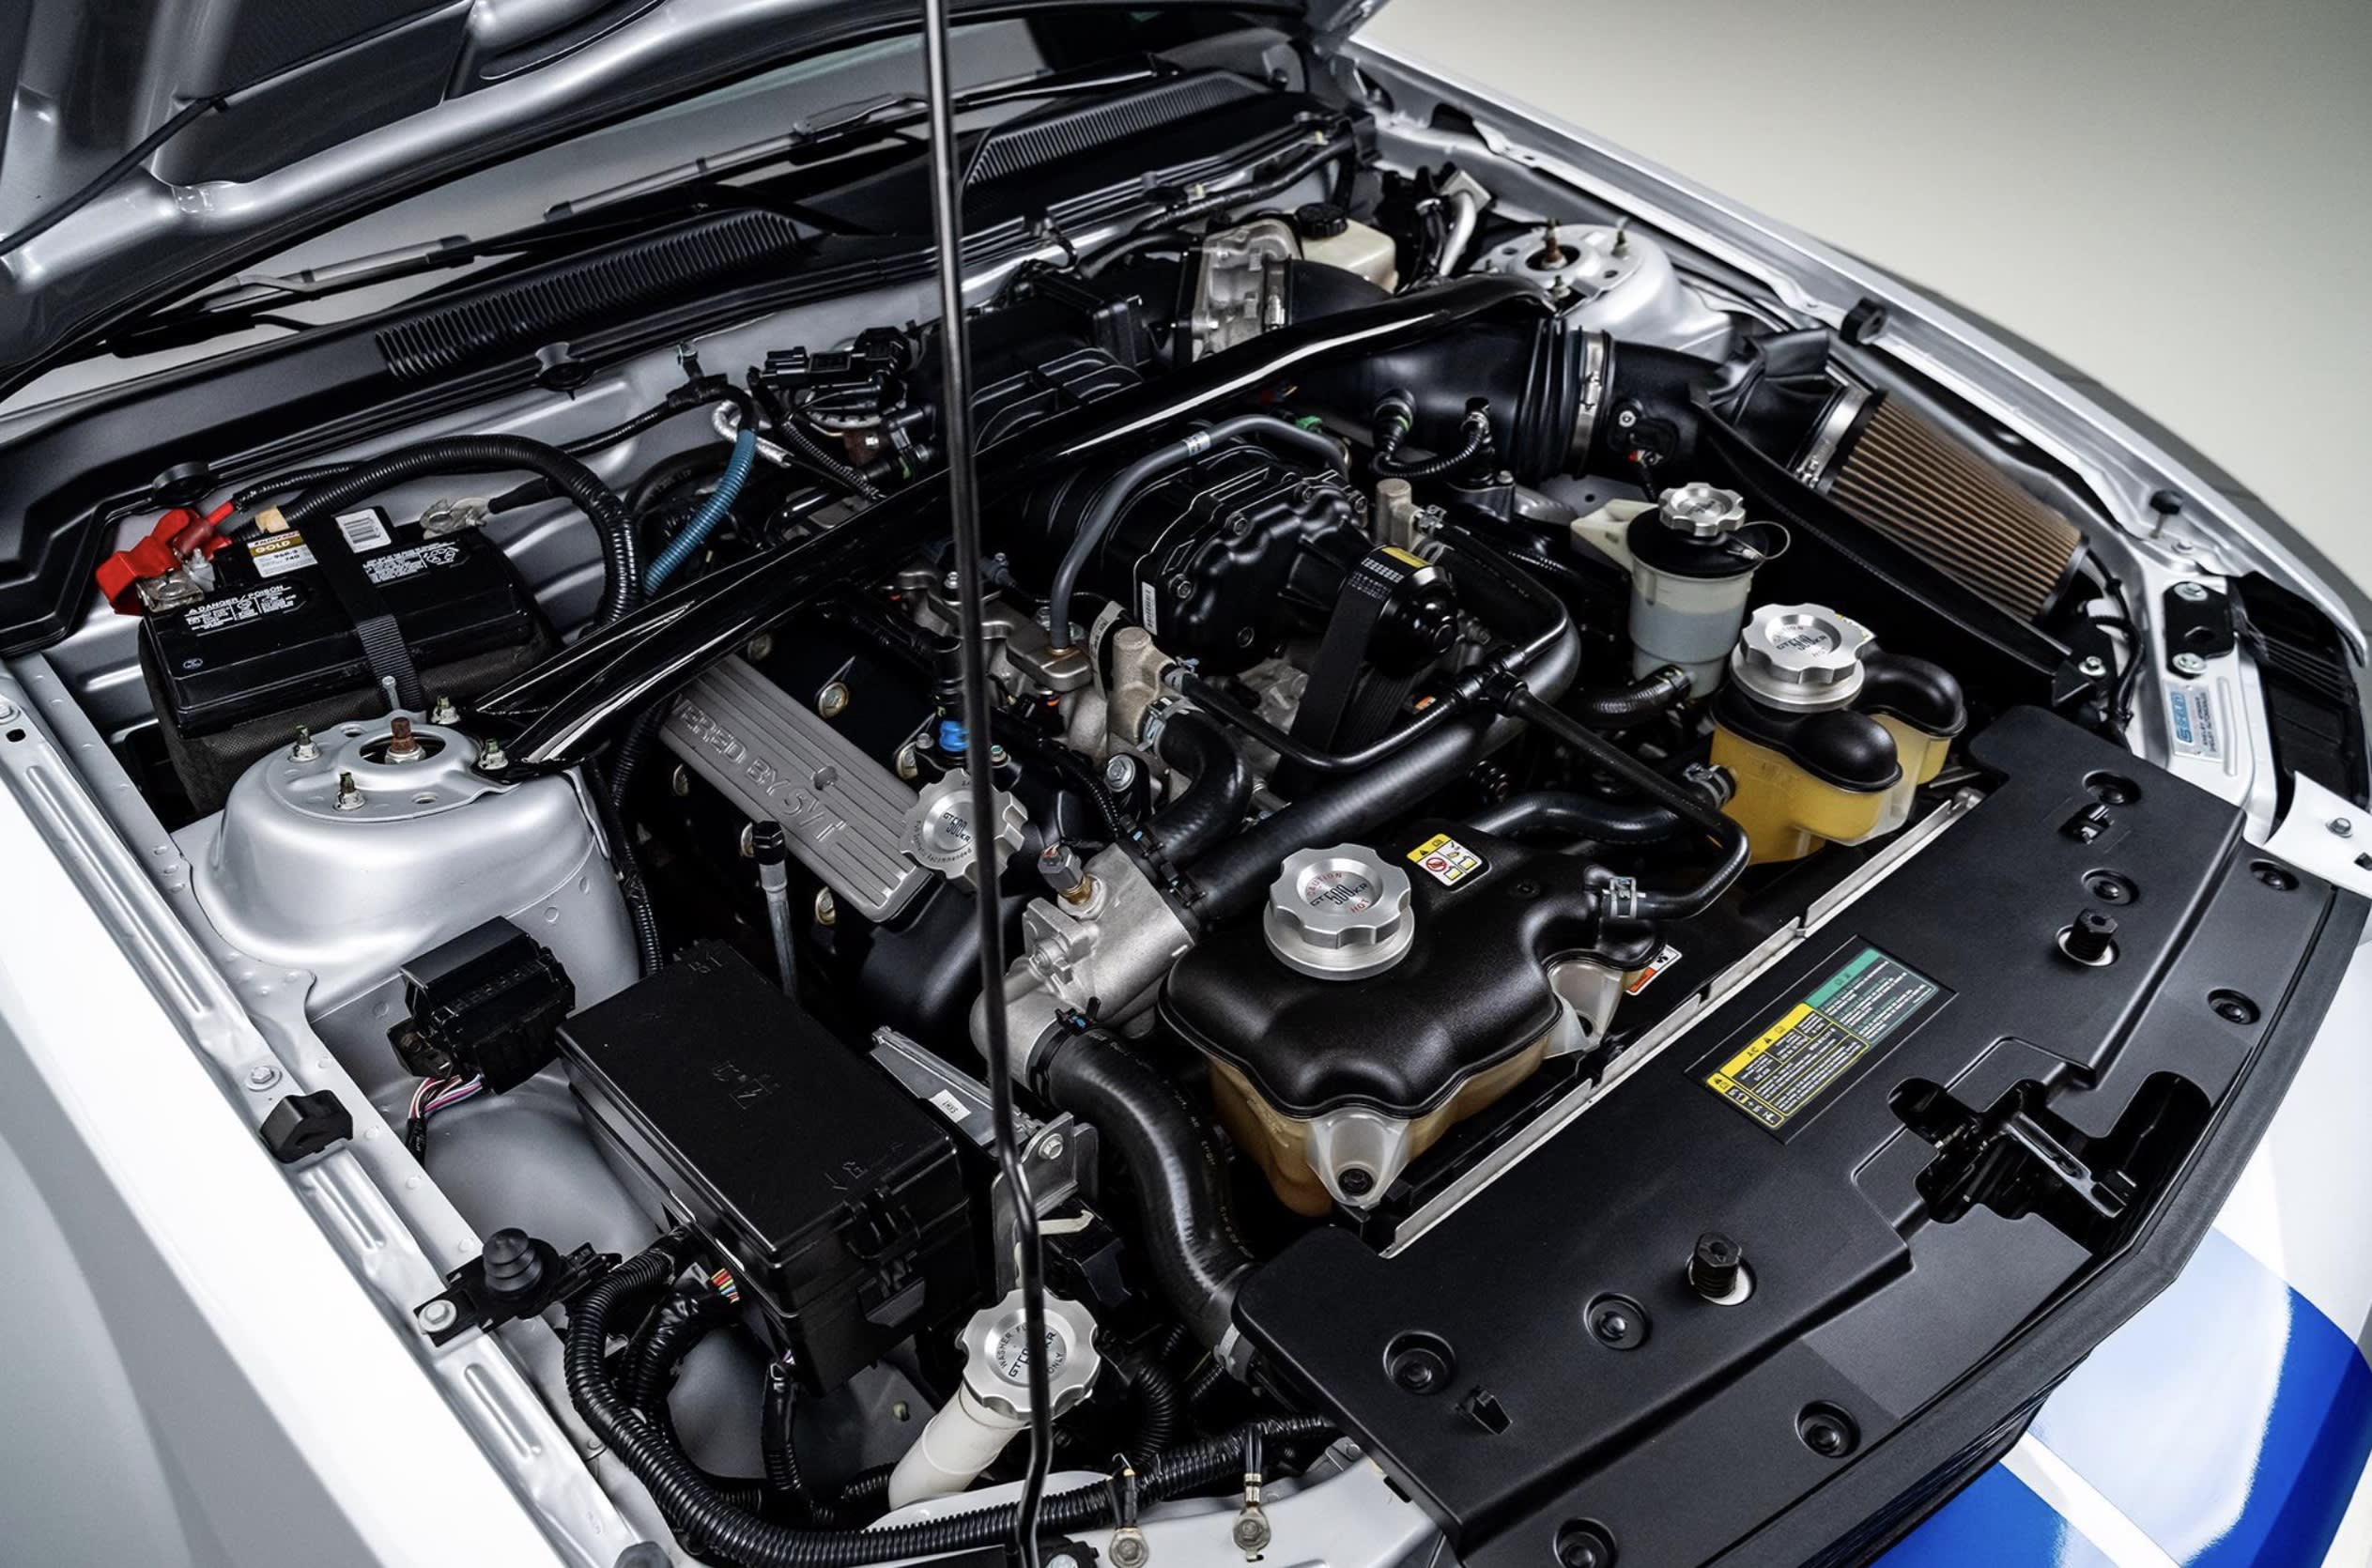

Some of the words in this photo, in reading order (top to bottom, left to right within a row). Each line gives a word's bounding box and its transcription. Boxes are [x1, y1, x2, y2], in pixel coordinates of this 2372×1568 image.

[255, 540, 291, 554] GOLD
[746, 758, 792, 797] BY
[782, 790, 848, 842] SVT
[1306, 870, 1343, 898] CAUTION
[1350, 898, 1370, 914] HOT
[997, 1331, 1013, 1370] WASHER
